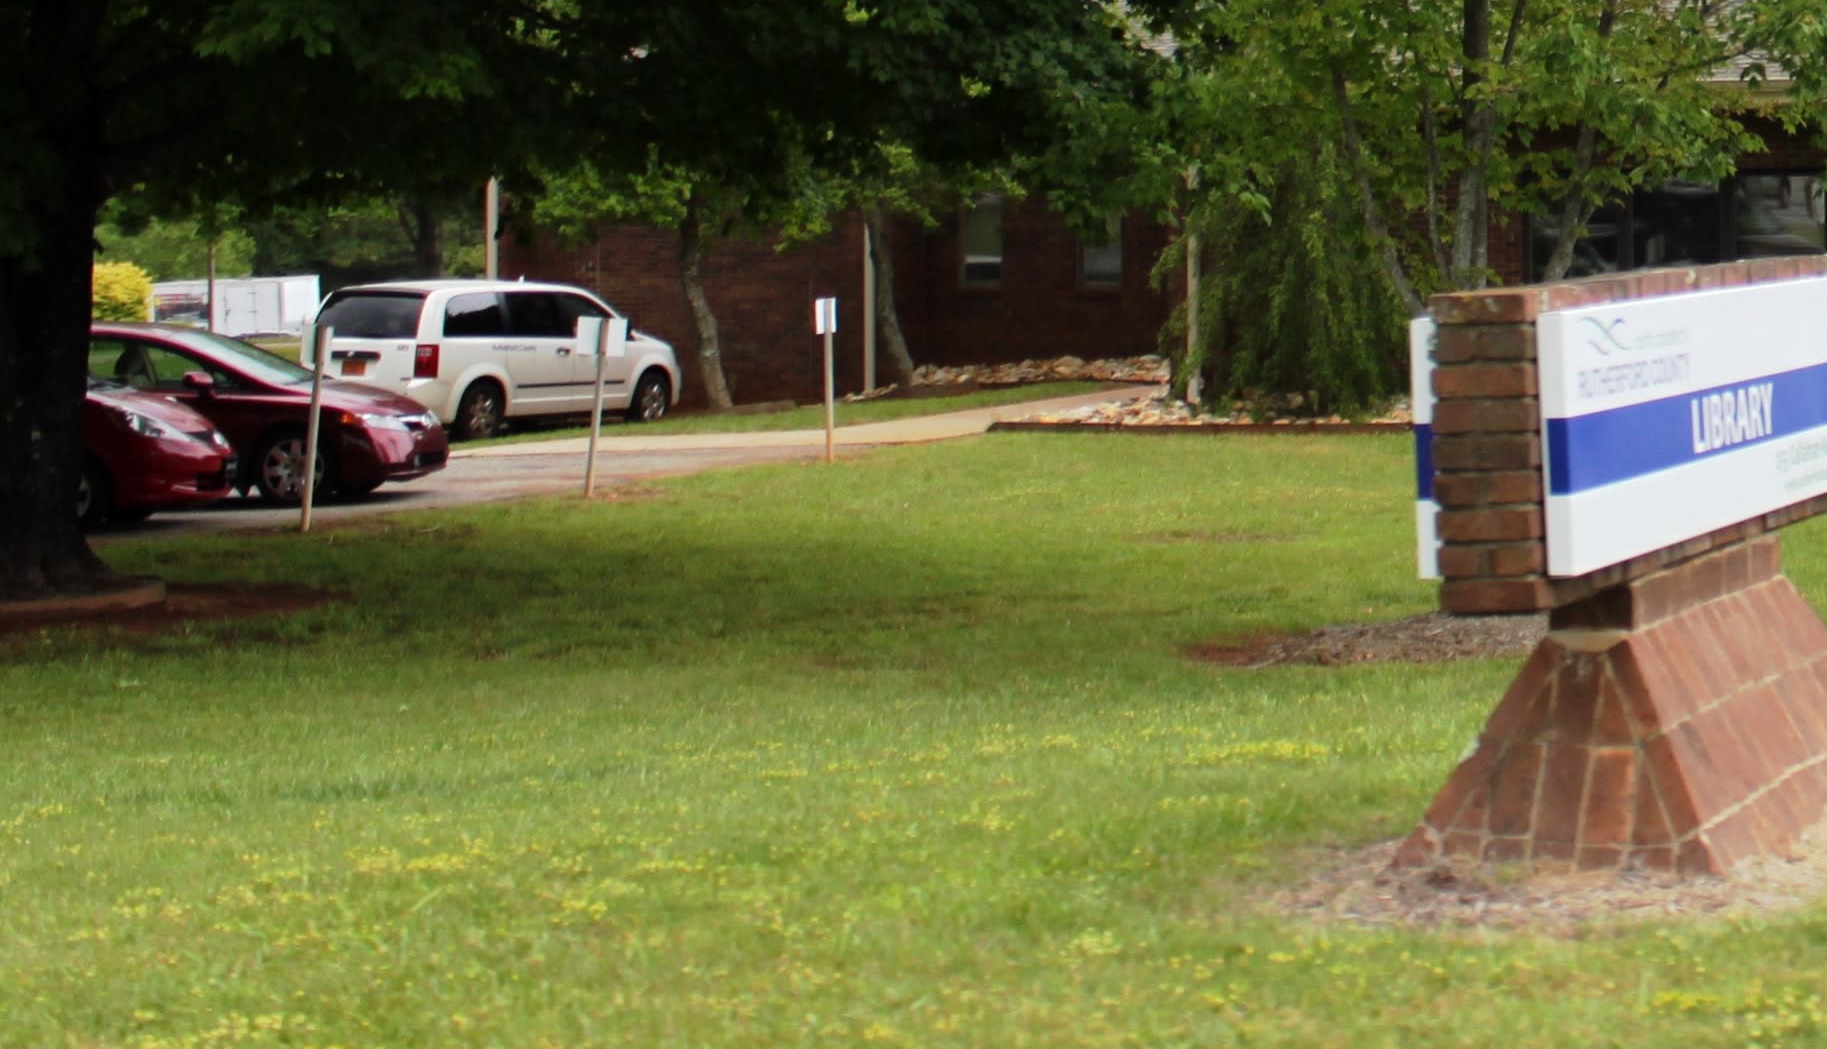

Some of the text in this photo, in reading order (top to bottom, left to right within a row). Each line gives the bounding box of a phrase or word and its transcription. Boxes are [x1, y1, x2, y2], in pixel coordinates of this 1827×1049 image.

[1579, 353, 1690, 396] RUTHERFORD COUNTY
[1691, 383, 1773, 454] LIBRARY
